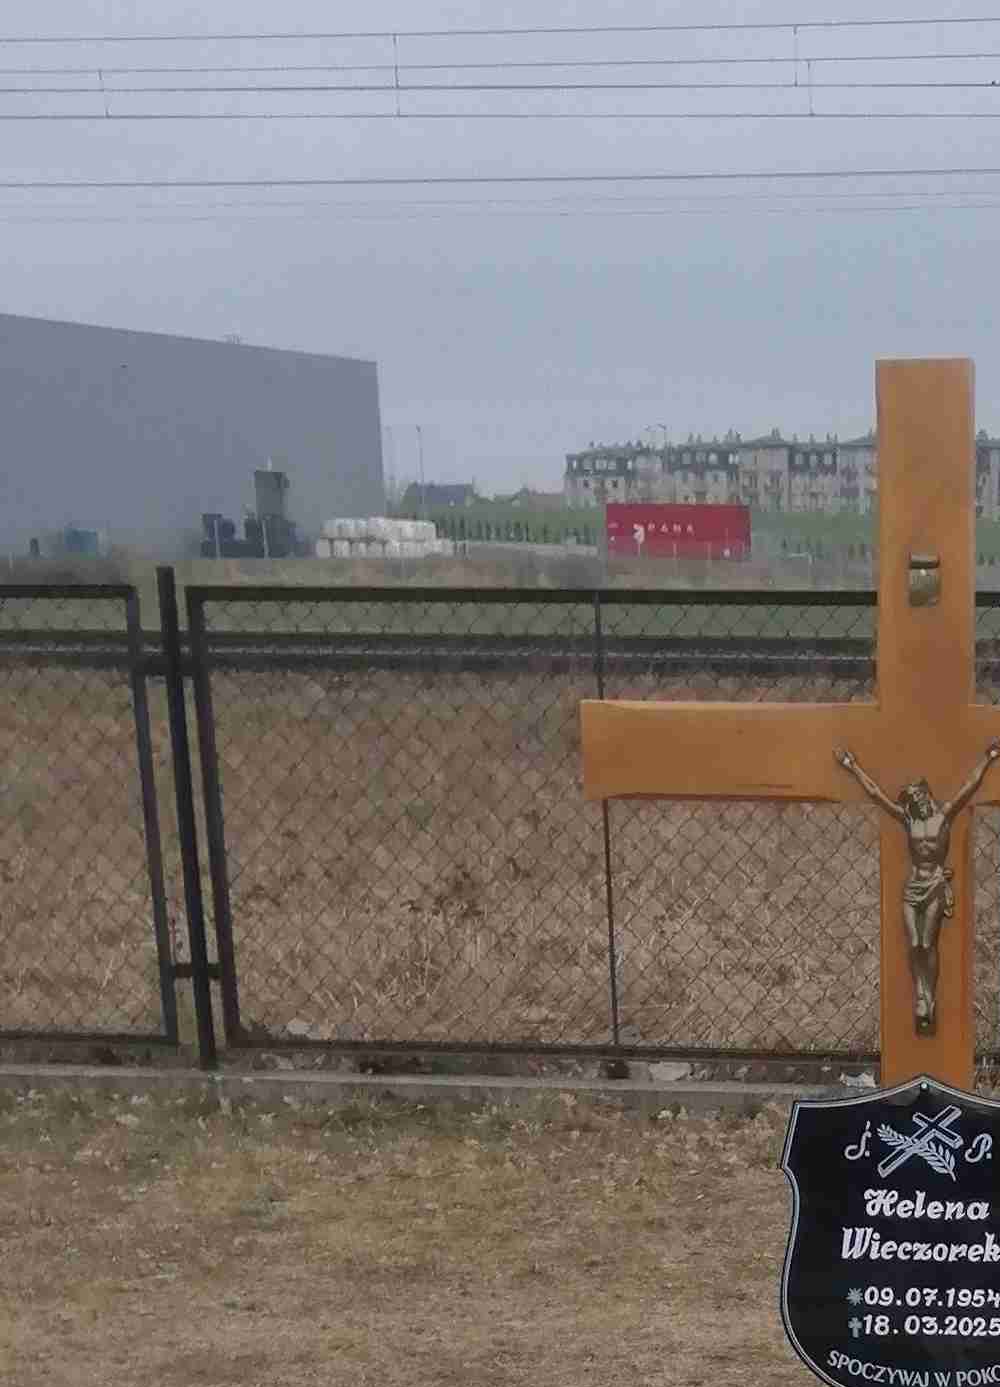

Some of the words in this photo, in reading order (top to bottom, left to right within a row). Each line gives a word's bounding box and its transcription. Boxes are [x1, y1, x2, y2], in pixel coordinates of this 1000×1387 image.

[964, 1133, 993, 1163] P.
[863, 1188, 991, 1220] Helena
[826, 1349, 930, 1387] SPOCZYWAJ
[934, 1371, 951, 1387] W
